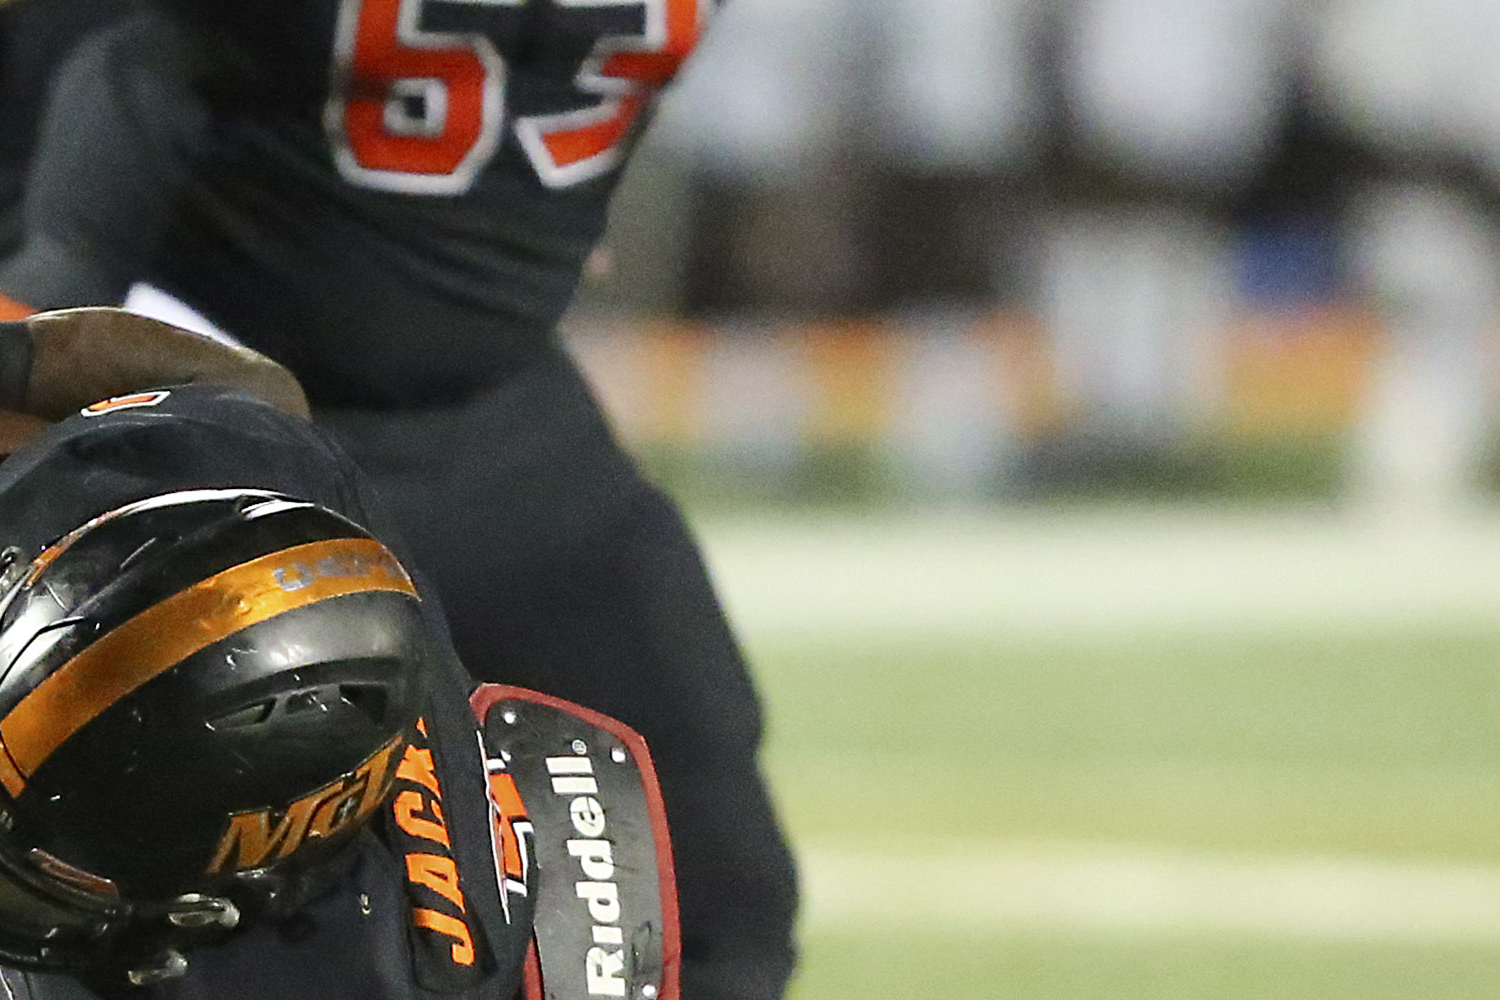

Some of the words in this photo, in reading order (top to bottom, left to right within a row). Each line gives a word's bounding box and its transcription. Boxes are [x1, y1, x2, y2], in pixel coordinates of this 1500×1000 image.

[323, 0, 703, 196] 63
[394, 716, 476, 967] JACK
[545, 755, 626, 997] Riddell
